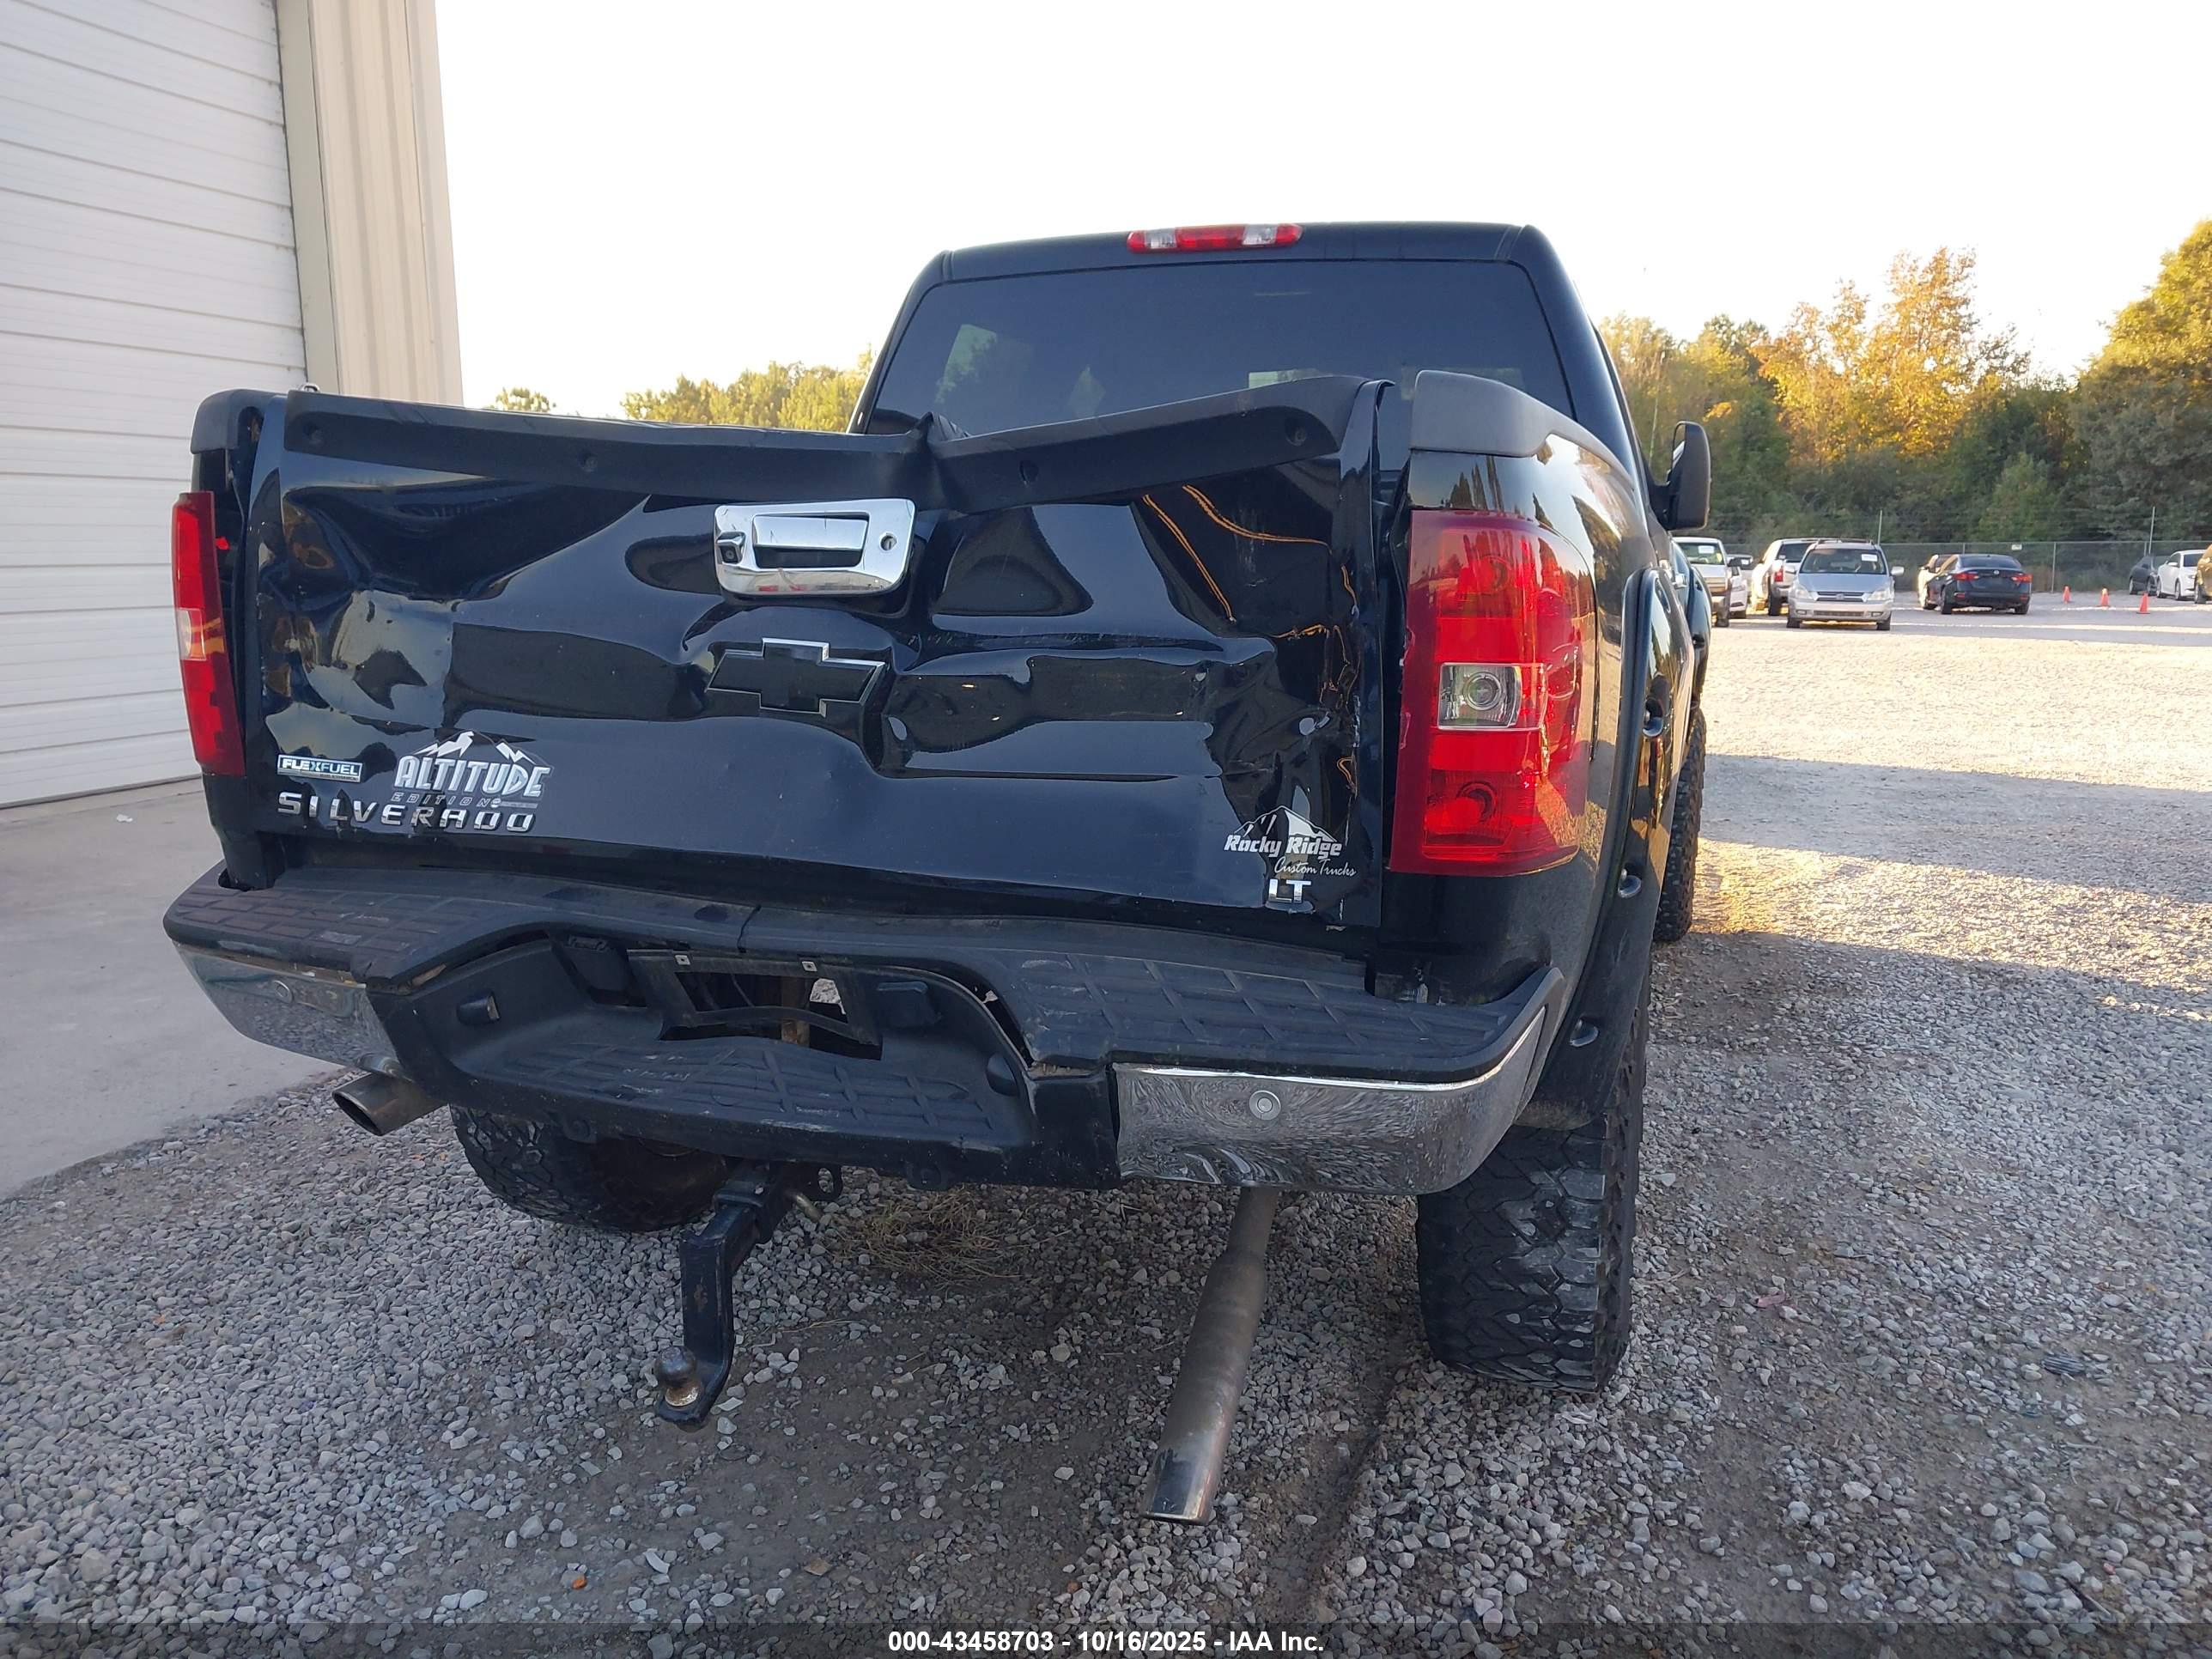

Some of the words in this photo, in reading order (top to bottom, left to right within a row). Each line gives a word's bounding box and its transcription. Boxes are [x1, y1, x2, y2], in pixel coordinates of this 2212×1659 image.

[282, 757, 358, 775] FLEXFUEL
[394, 757, 552, 797] ALTITUDE
[391, 792, 490, 808] EDITION
[278, 792, 534, 832] SILVERADO
[1224, 835, 1281, 857] Rocky
[1286, 837, 1342, 859] Ridge
[1274, 857, 1317, 874] Custom
[1320, 859, 1357, 877] Trucks
[1269, 879, 1311, 902] LT
